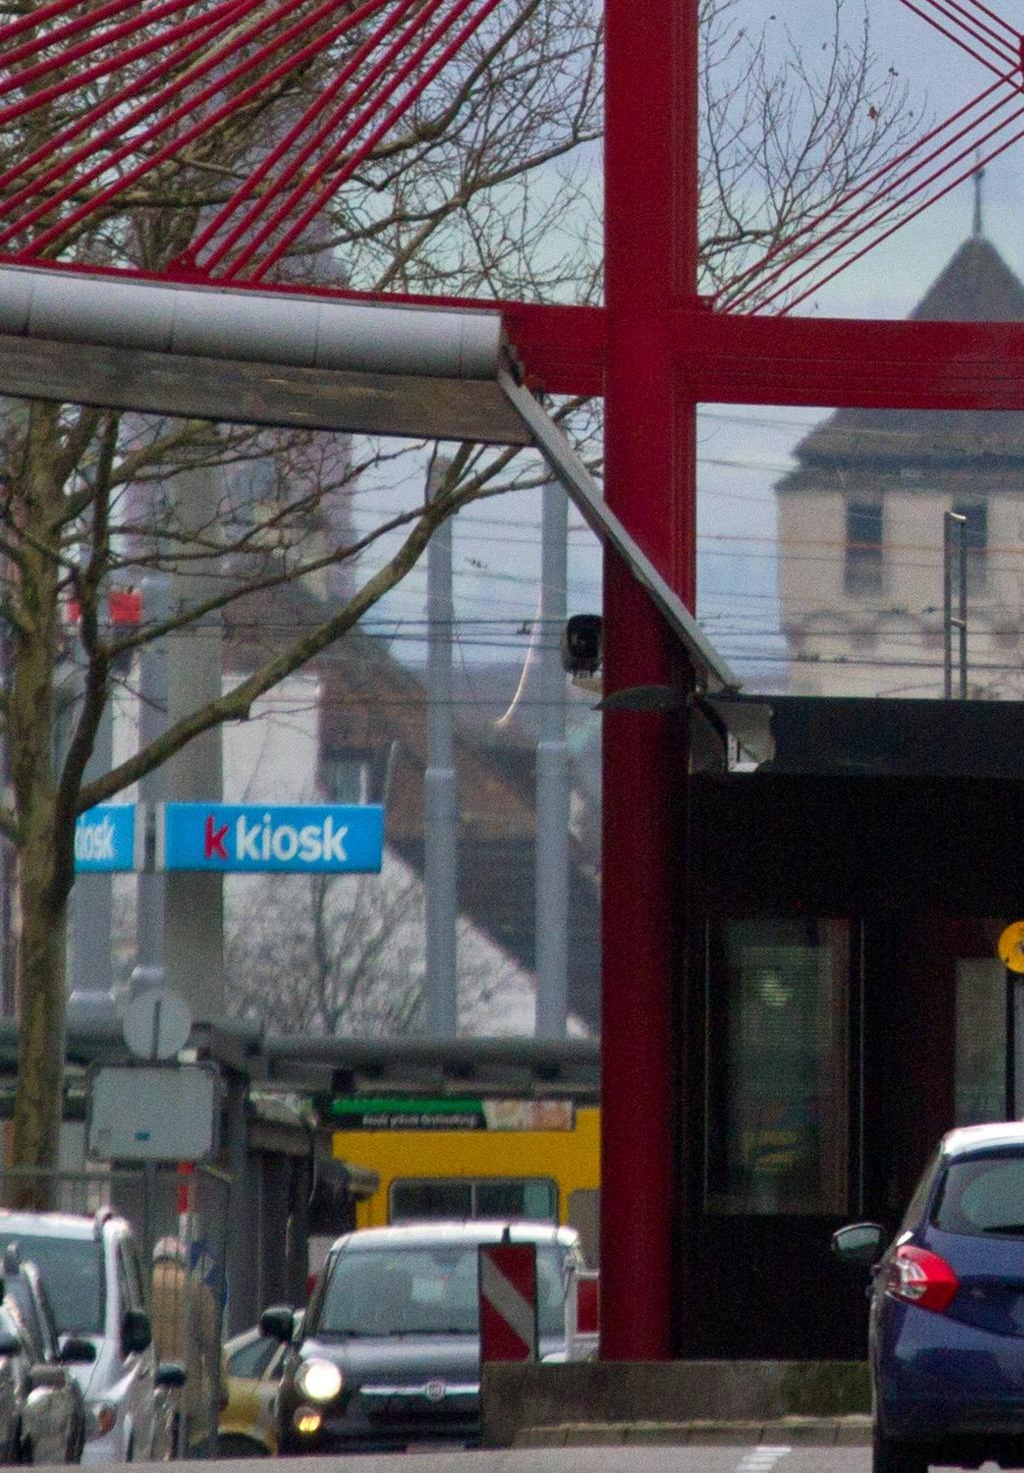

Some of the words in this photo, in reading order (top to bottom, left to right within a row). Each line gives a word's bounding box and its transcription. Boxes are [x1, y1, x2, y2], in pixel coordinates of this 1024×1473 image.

[74, 814, 117, 861] iosk
[204, 814, 230, 860] k
[236, 813, 349, 862] kiosk
